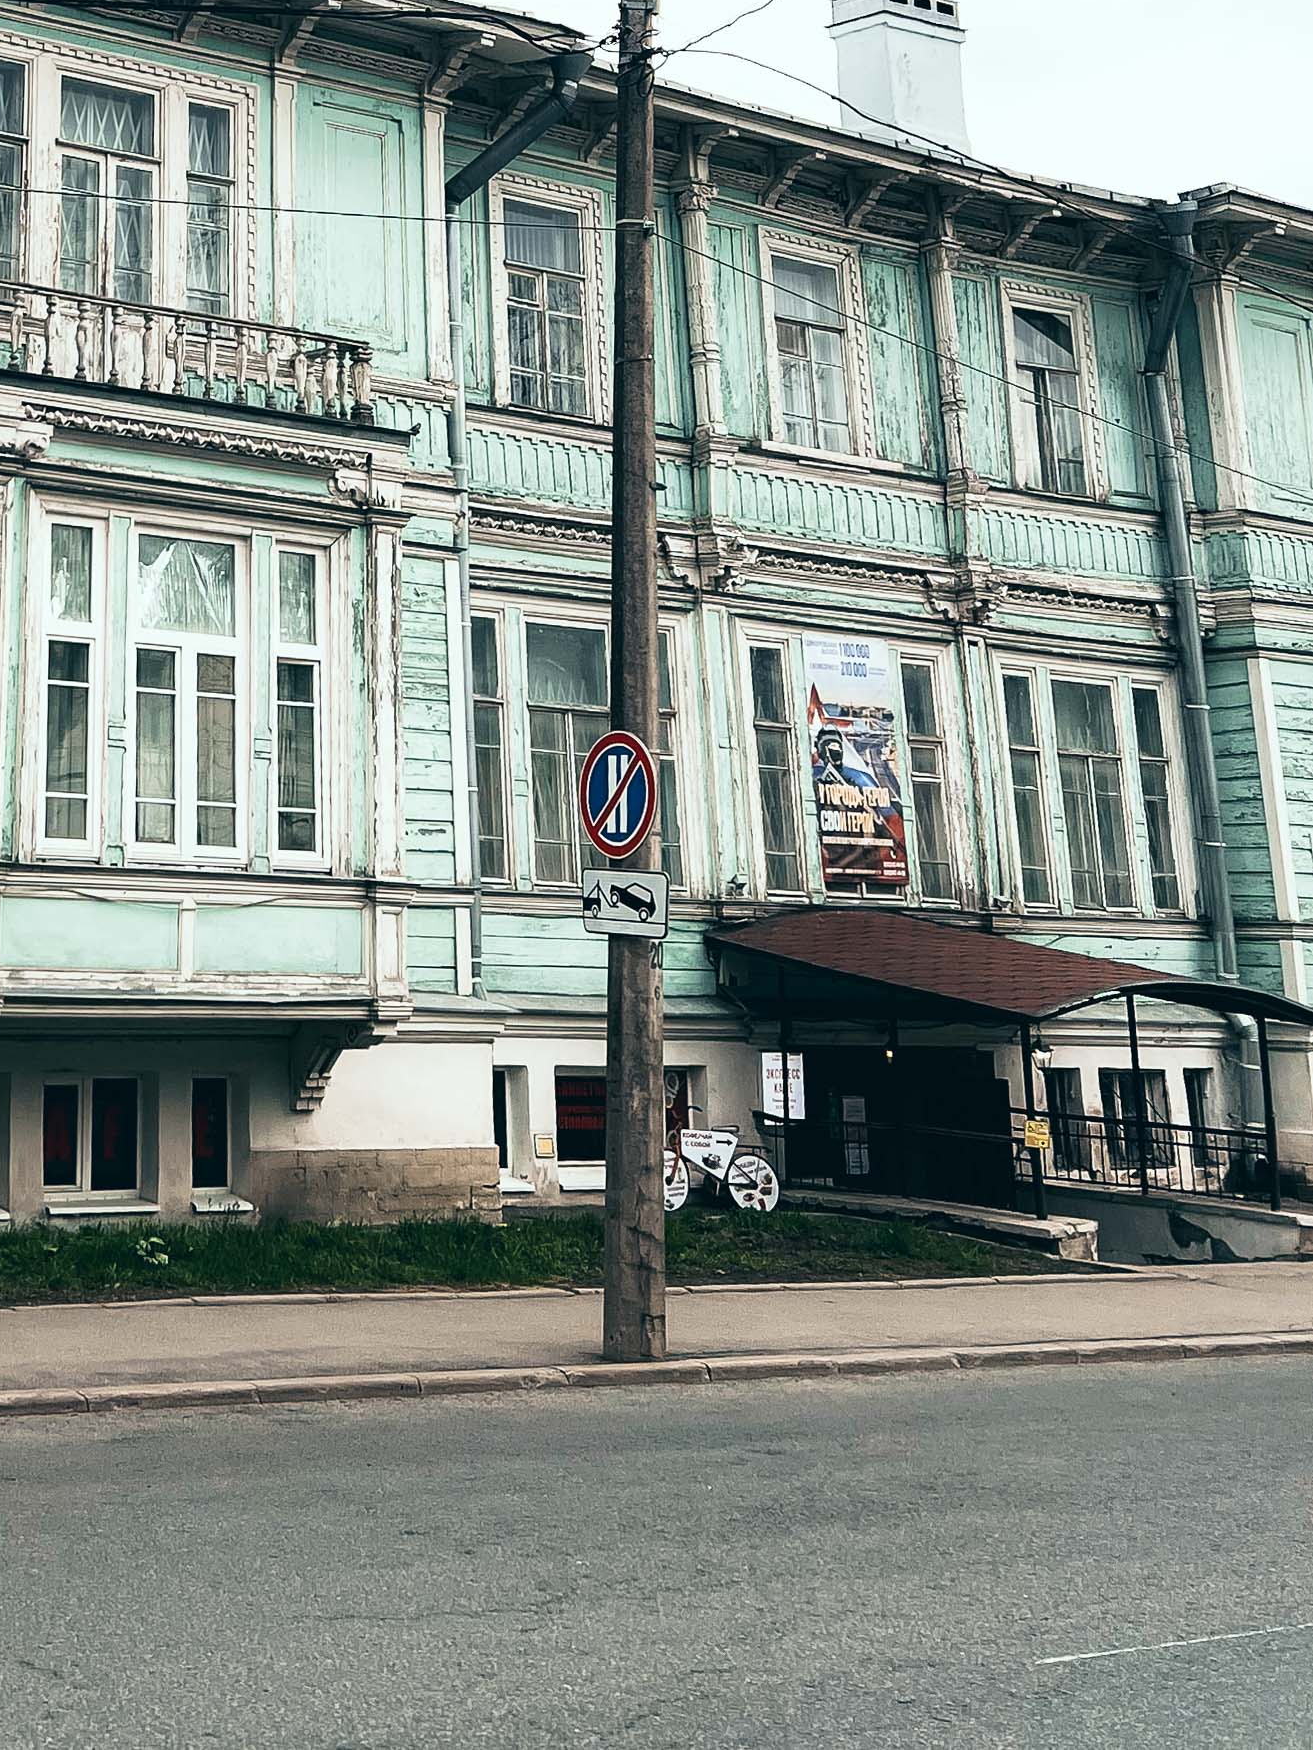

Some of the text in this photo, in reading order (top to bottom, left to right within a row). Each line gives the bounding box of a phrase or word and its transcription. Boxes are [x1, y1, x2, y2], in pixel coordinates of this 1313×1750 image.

[820, 810, 847, 832] СВОИ
[649, 941, 664, 969] 20
[654, 986, 661, 1001] 6
[766, 1068, 801, 1080] ЭКСПЕСС
[774, 1082, 793, 1093] КАЕ
